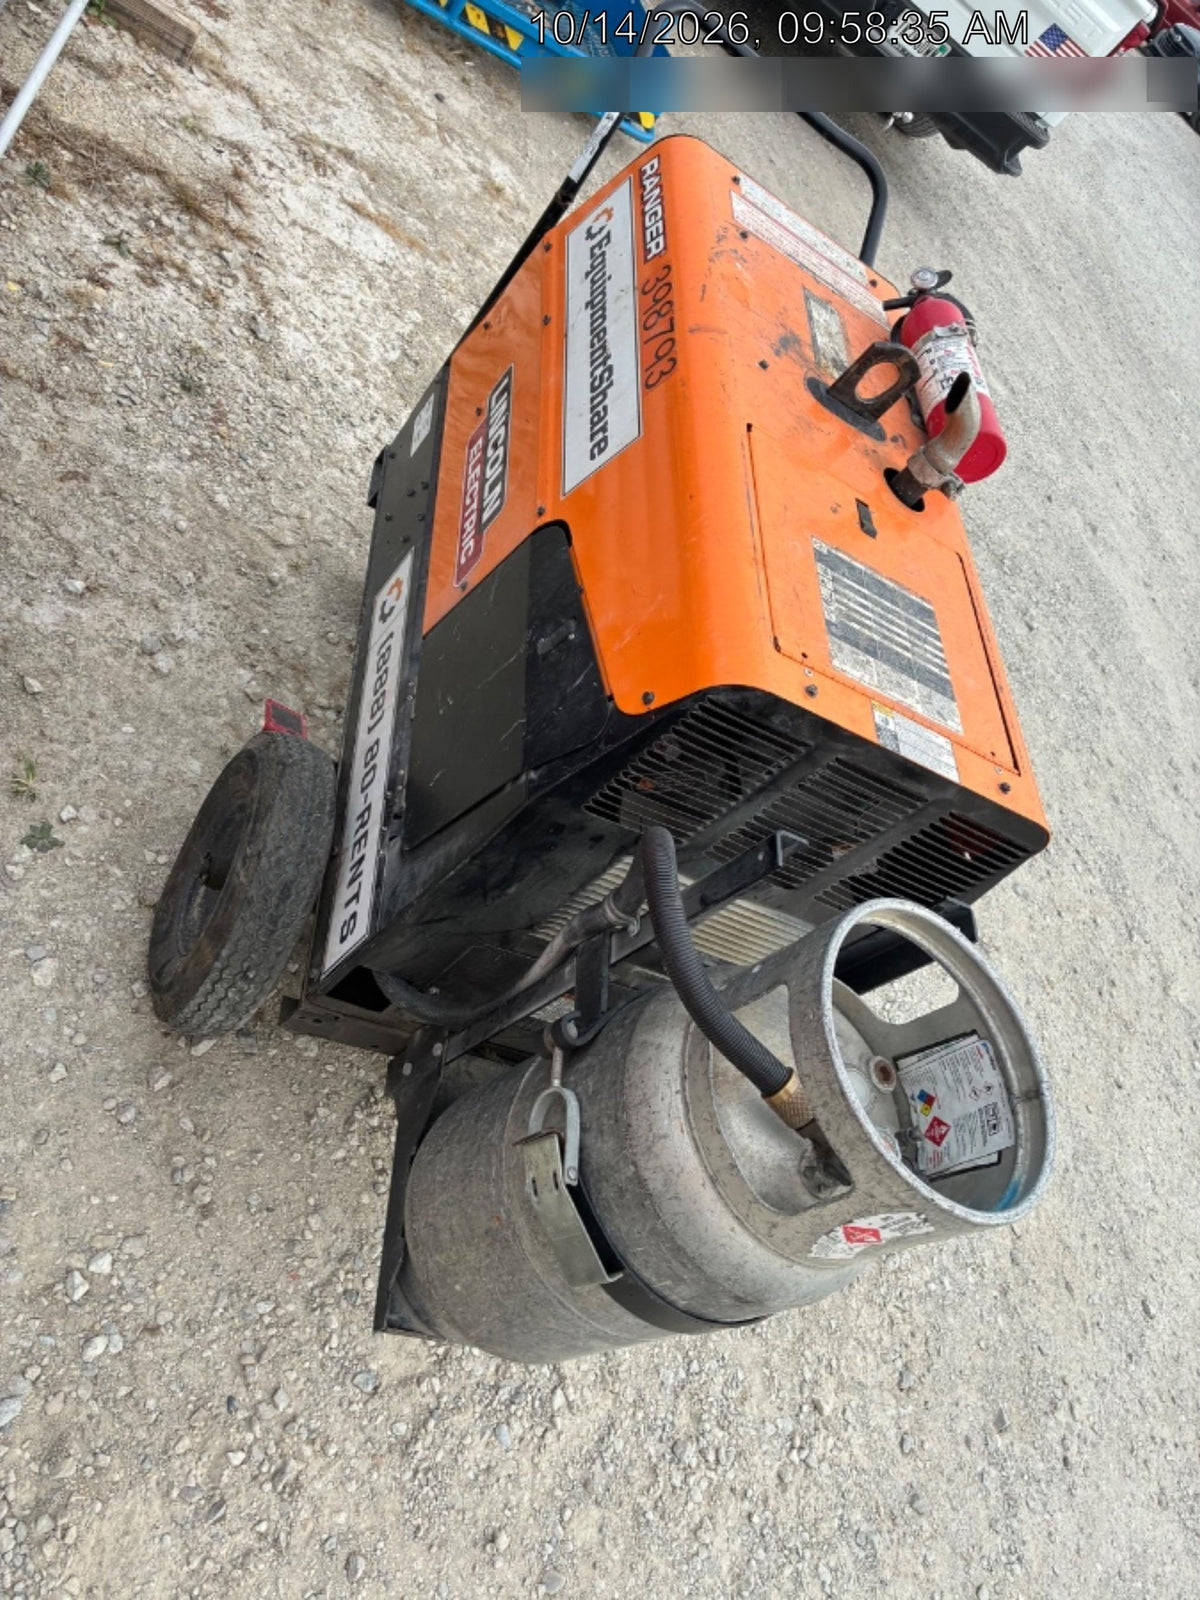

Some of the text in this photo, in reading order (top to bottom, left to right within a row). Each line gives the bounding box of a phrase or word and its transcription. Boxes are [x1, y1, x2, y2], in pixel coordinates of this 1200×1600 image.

[641, 156, 665, 260] RANGER
[585, 229, 614, 461] EquipmentShare
[641, 264, 677, 390] 398793
[460, 436, 484, 565] ELECTRIC
[481, 376, 509, 525] LINCOLN
[339, 631, 394, 944] (888) 80-RENTS
